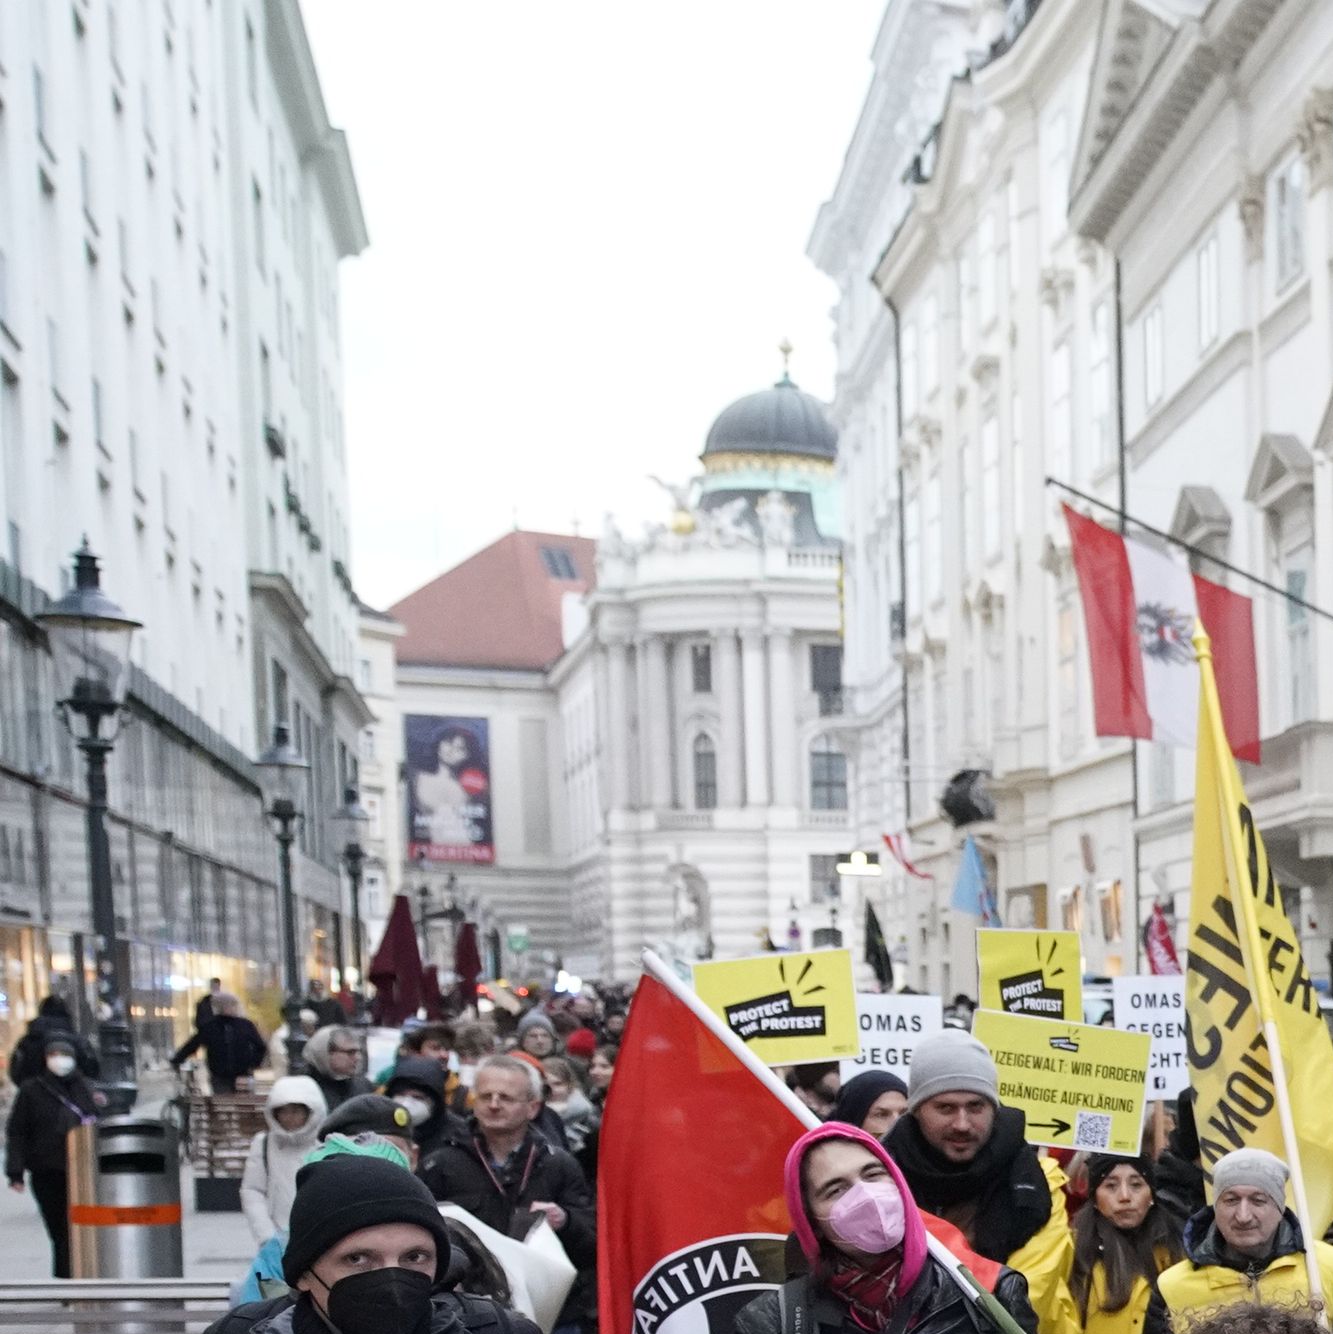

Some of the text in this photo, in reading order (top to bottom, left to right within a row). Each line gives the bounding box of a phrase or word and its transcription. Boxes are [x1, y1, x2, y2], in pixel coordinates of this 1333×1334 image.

[1002, 979, 1042, 1001] PROTECT
[1130, 993, 1182, 1009] OMAS
[729, 999, 790, 1026] PROTECT
[1023, 997, 1062, 1013] PROTEST
[739, 1015, 823, 1037] THE PROTEST
[860, 1013, 922, 1032] OMAS
[1071, 1061, 1092, 1077] WIR
[1095, 1064, 1146, 1085] FORDERN
[1061, 1090, 1134, 1114] AUFKLÄRUNG
